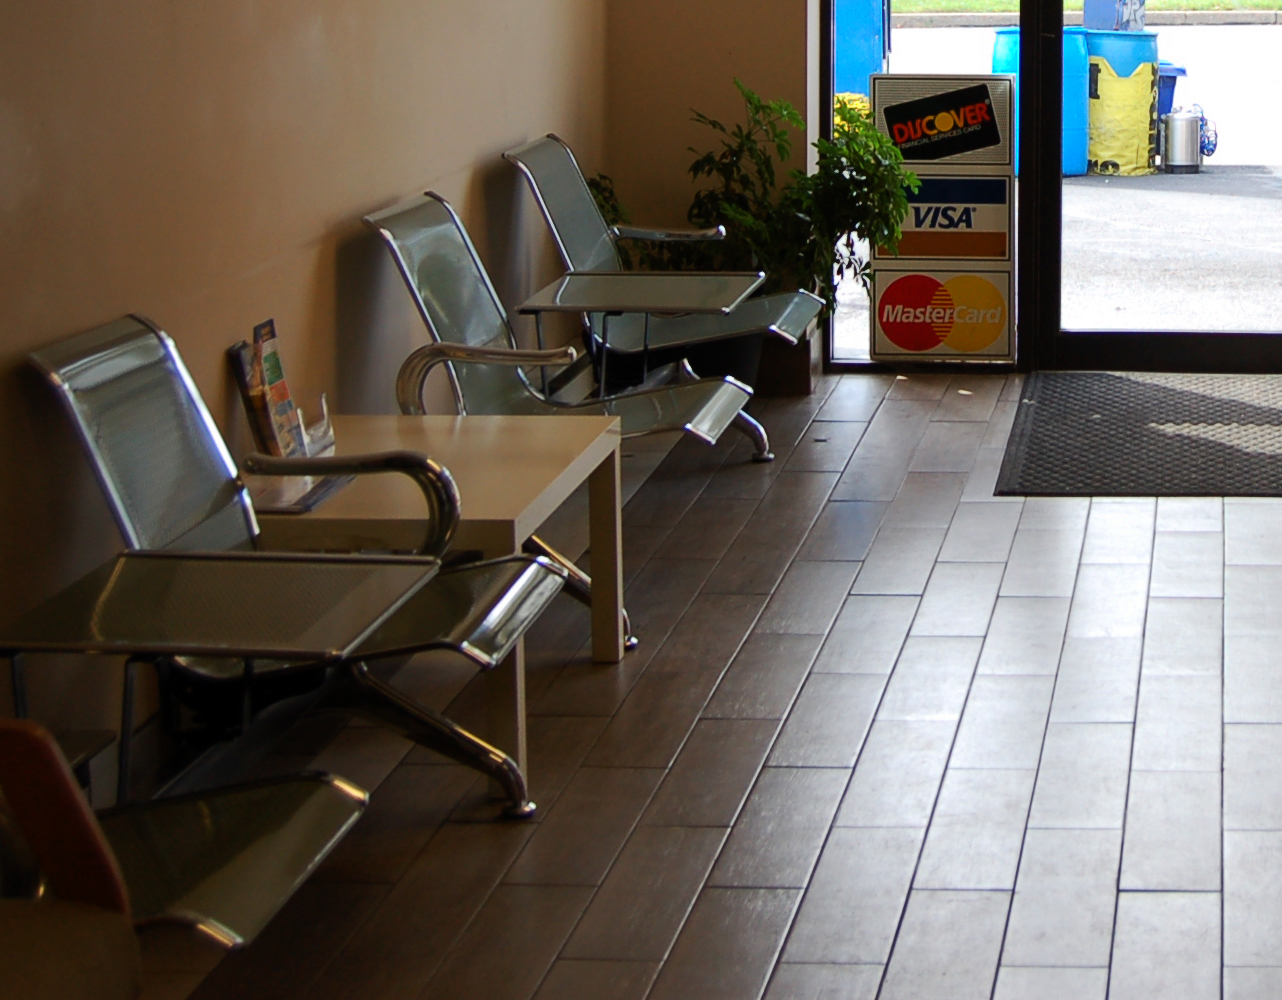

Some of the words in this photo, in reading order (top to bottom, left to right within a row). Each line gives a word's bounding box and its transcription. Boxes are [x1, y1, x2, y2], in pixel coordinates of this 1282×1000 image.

[893, 103, 990, 143] DISCOVER
[930, 128, 962, 141] SERVICES
[963, 123, 981, 134] CARD
[912, 206, 974, 229] VISA
[882, 305, 1001, 324] MasterCard
